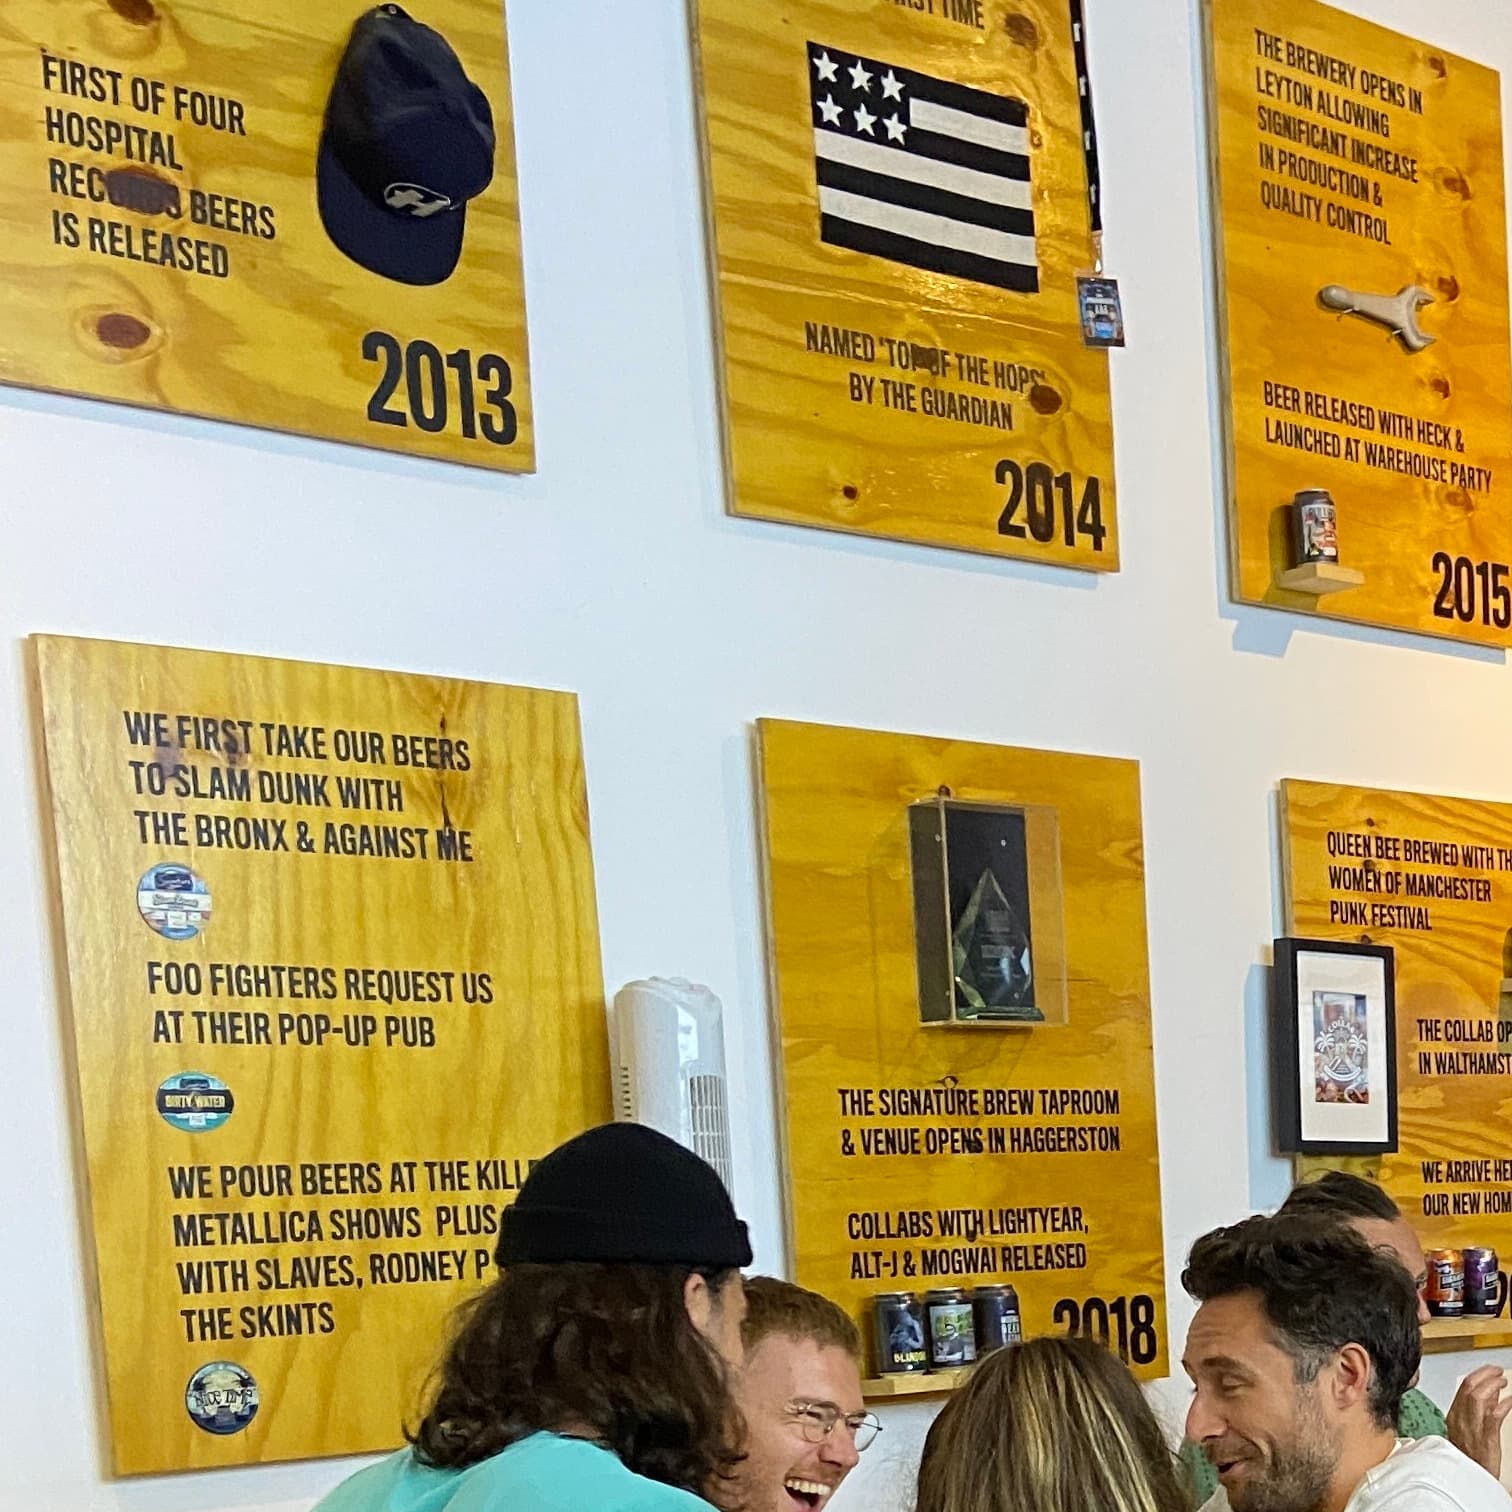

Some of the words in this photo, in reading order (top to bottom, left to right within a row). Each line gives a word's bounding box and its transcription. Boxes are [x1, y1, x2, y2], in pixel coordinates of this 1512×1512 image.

[42, 53, 121, 104] FIRST
[131, 77, 165, 114] OF
[174, 87, 246, 136] FOUR
[1255, 29, 1282, 64] THE
[1286, 39, 1356, 90] BREWERY
[1361, 69, 1405, 107] OPENS
[1409, 84, 1422, 114] IN
[1256, 67, 1313, 111] LEYTON
[1317, 85, 1389, 138] ALLOWING
[46, 107, 182, 170] HOSPITAL
[1257, 107, 1348, 157] SIGNIFICANT
[1351, 138, 1418, 183] INCREASE
[49, 158, 180, 218] RECS
[191, 191, 275, 239] BEERS
[1260, 142, 1274, 171] IN
[1278, 149, 1370, 202] PRODUCTION
[1372, 183, 1383, 207] &
[1261, 181, 1321, 223] QUALITY
[1326, 205, 1391, 245] CONTROL
[53, 210, 79, 247] IS
[89, 221, 228, 278] RELEASED
[805, 323, 875, 362] NAMED
[879, 337, 918, 372] 'TO
[955, 354, 990, 386] THE
[362, 331, 517, 444] 2013
[850, 373, 875, 404] BY
[880, 379, 916, 412] THE
[921, 387, 1013, 431] GUARDIAN
[1264, 381, 1300, 414] BEER
[1305, 390, 1374, 433] RELEASED
[1379, 409, 1415, 442] WITH
[1417, 418, 1452, 450] HECK
[1455, 430, 1465, 454] &
[1266, 417, 1341, 459] LAUNCHED
[1345, 436, 1361, 464] AT
[1365, 440, 1447, 485] WAREHOUSE
[1451, 461, 1493, 494] PARTY
[996, 459, 1106, 551] 2014
[1433, 552, 1511, 629] 2015
[124, 711, 170, 746] WE
[178, 714, 253, 754] FIRST
[260, 722, 327, 760] TAKE
[334, 729, 385, 764] OUR
[392, 734, 471, 771] BEERS
[129, 761, 165, 795] TO
[172, 765, 250, 802] SLAM
[258, 771, 330, 808] DUNK
[336, 778, 403, 812] WITH
[134, 810, 188, 846] THE
[195, 814, 289, 852] BRONX
[296, 821, 315, 853] &
[324, 824, 428, 860] AGAINST
[436, 830, 473, 862] ME
[1327, 831, 1370, 858] QUEEN
[1375, 835, 1400, 861] BEE
[1404, 838, 1459, 866] BREWED
[1462, 843, 1494, 869] WITH
[1329, 865, 1381, 893] WOMEN
[1386, 870, 1402, 895] OF
[1406, 873, 1491, 902] MANCHESTER
[1331, 903, 1366, 926] PUNK
[1372, 904, 1431, 930] FESTIVAL
[147, 962, 202, 996] FOO
[210, 964, 337, 1000] FIGHTERS
[345, 968, 454, 1003] REQUEST
[461, 973, 494, 1004] US
[153, 1011, 186, 1045] AT
[192, 1012, 272, 1046] THEIR
[279, 1013, 376, 1048] POP-UP
[385, 1015, 436, 1048] PUB
[1417, 1019, 1441, 1041] THE
[1445, 1019, 1493, 1042] COLLAB
[1419, 1053, 1431, 1074] IN
[838, 1089, 875, 1115] THE
[879, 1089, 979, 1115] SIGNATURE
[983, 1089, 1033, 1115] BREW
[1039, 1089, 1120, 1115] TAPROOM
[842, 1130, 856, 1155] &
[861, 1129, 921, 1155] VENUE
[926, 1128, 982, 1154] OPENS
[989, 1128, 1005, 1153] IN
[1010, 1127, 1120, 1152] HAGGERSTON
[169, 1165, 213, 1200] WE
[221, 1164, 293, 1198] POUR
[301, 1162, 381, 1196] BEERS
[390, 1162, 416, 1193] AT
[424, 1161, 470, 1192] THE
[1422, 1161, 1442, 1183] WE
[1446, 1160, 1491, 1182] ARRIVE
[174, 1212, 323, 1247] METALLICA
[331, 1208, 421, 1240] SHOWS
[437, 1205, 497, 1236] PLUS
[848, 1210, 933, 1240] COLLABS
[938, 1209, 984, 1237] WITH
[990, 1207, 1089, 1235] LIGHTYEAR,
[1423, 1193, 1448, 1216] OUR
[1453, 1192, 1480, 1215] NEW
[177, 1260, 249, 1294] WITH
[257, 1256, 362, 1290] SLAVES,
[370, 1251, 466, 1284] RODNEY
[476, 1250, 489, 1280] P
[851, 1251, 898, 1279] ALT-J
[903, 1250, 916, 1276] &
[922, 1248, 997, 1275] MOGWAI
[1002, 1244, 1086, 1271] RELEASED
[181, 1308, 234, 1342] THE
[241, 1303, 334, 1337] SKINTS
[1054, 1296, 1155, 1365] 2018
